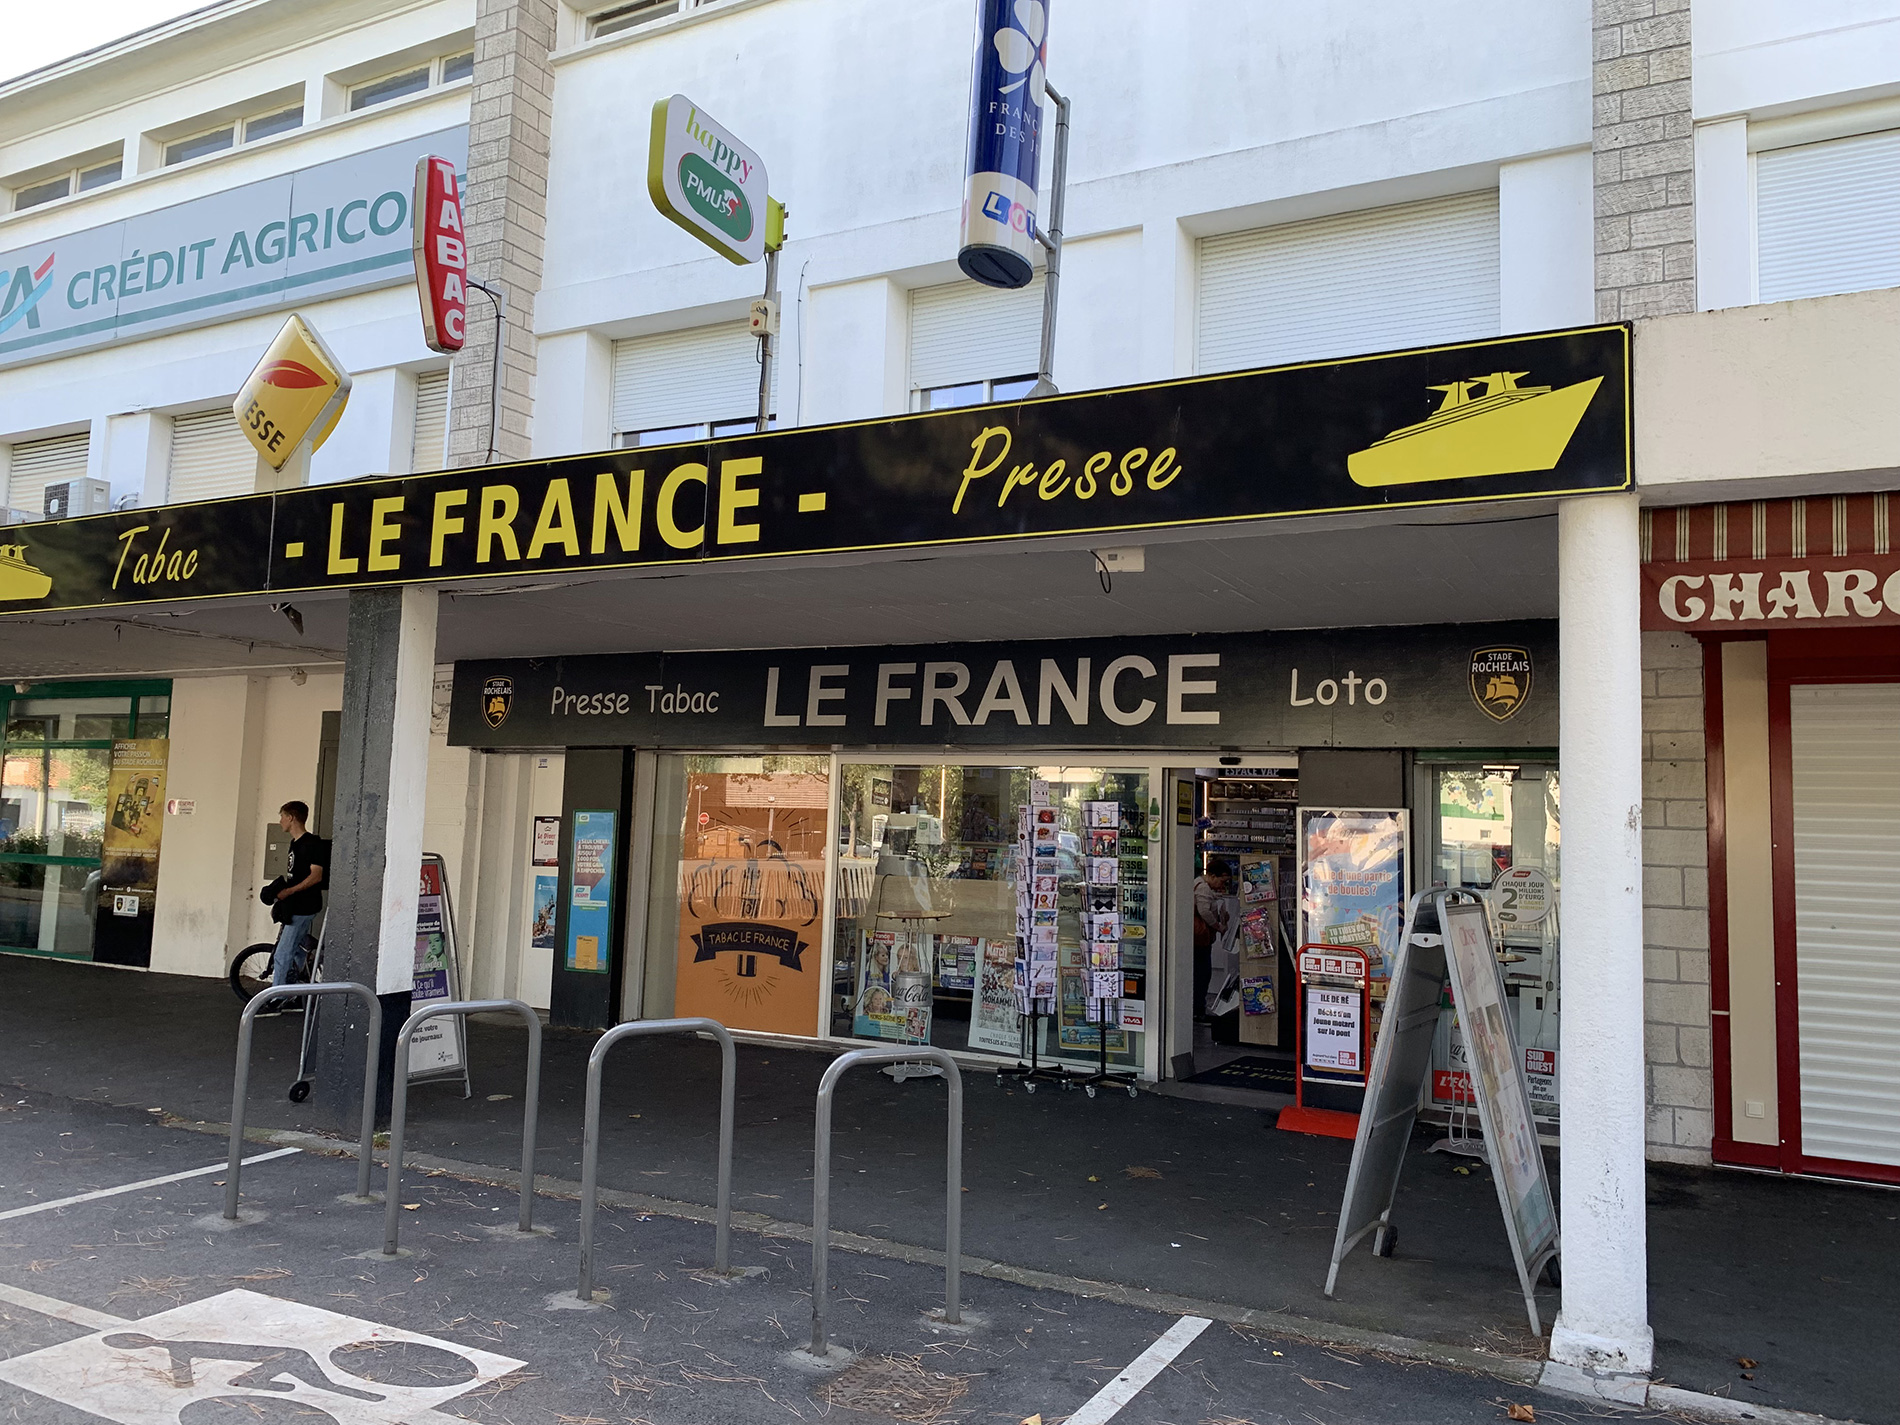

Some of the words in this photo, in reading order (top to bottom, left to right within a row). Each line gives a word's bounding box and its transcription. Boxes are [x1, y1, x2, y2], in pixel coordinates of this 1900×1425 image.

[995, 123, 1027, 143] DES
[685, 105, 752, 184] happy
[686, 170, 723, 208] PMU
[983, 192, 1036, 238] LOT
[67, 238, 216, 310] CRÉDIT
[220, 187, 416, 275] AGRICO
[436, 162, 466, 341] TABAC
[112, 525, 198, 590] Tabac
[327, 496, 405, 575] LE
[429, 456, 763, 567] FRANCE
[952, 426, 1182, 514] Presse
[1487, 652, 1513, 661] STADE
[1471, 661, 1530, 673] ROCHELAIS
[483, 687, 513, 695] ROCHELAIS
[551, 686, 630, 715] Presse
[645, 684, 719, 714] Tabac
[764, 664, 850, 727] LE
[874, 653, 1220, 727] FRANCE
[1290, 668, 1387, 706] Loto
[1120, 842, 1143, 855] abac
[1337, 869, 1362, 881] d'une
[1364, 871, 1392, 883] partie
[1328, 883, 1338, 895] de
[1340, 884, 1370, 896] boules
[1502, 888, 1517, 909] 2
[1123, 906, 1145, 920] PMU
[709, 932, 738, 944] TABAC
[741, 931, 751, 943] LE
[754, 933, 790, 951] FRANCE
[1321, 994, 1329, 1002] ILE
[1331, 995, 1339, 1003] DE
[1341, 995, 1349, 1004] RÉ
[1332, 1020, 1355, 1028] motard
[419, 1033, 443, 1043] journaux
[1336, 1030, 1350, 1038] pont
[1527, 1050, 1545, 1061] SUD
[1527, 1060, 1553, 1073] OUEST
